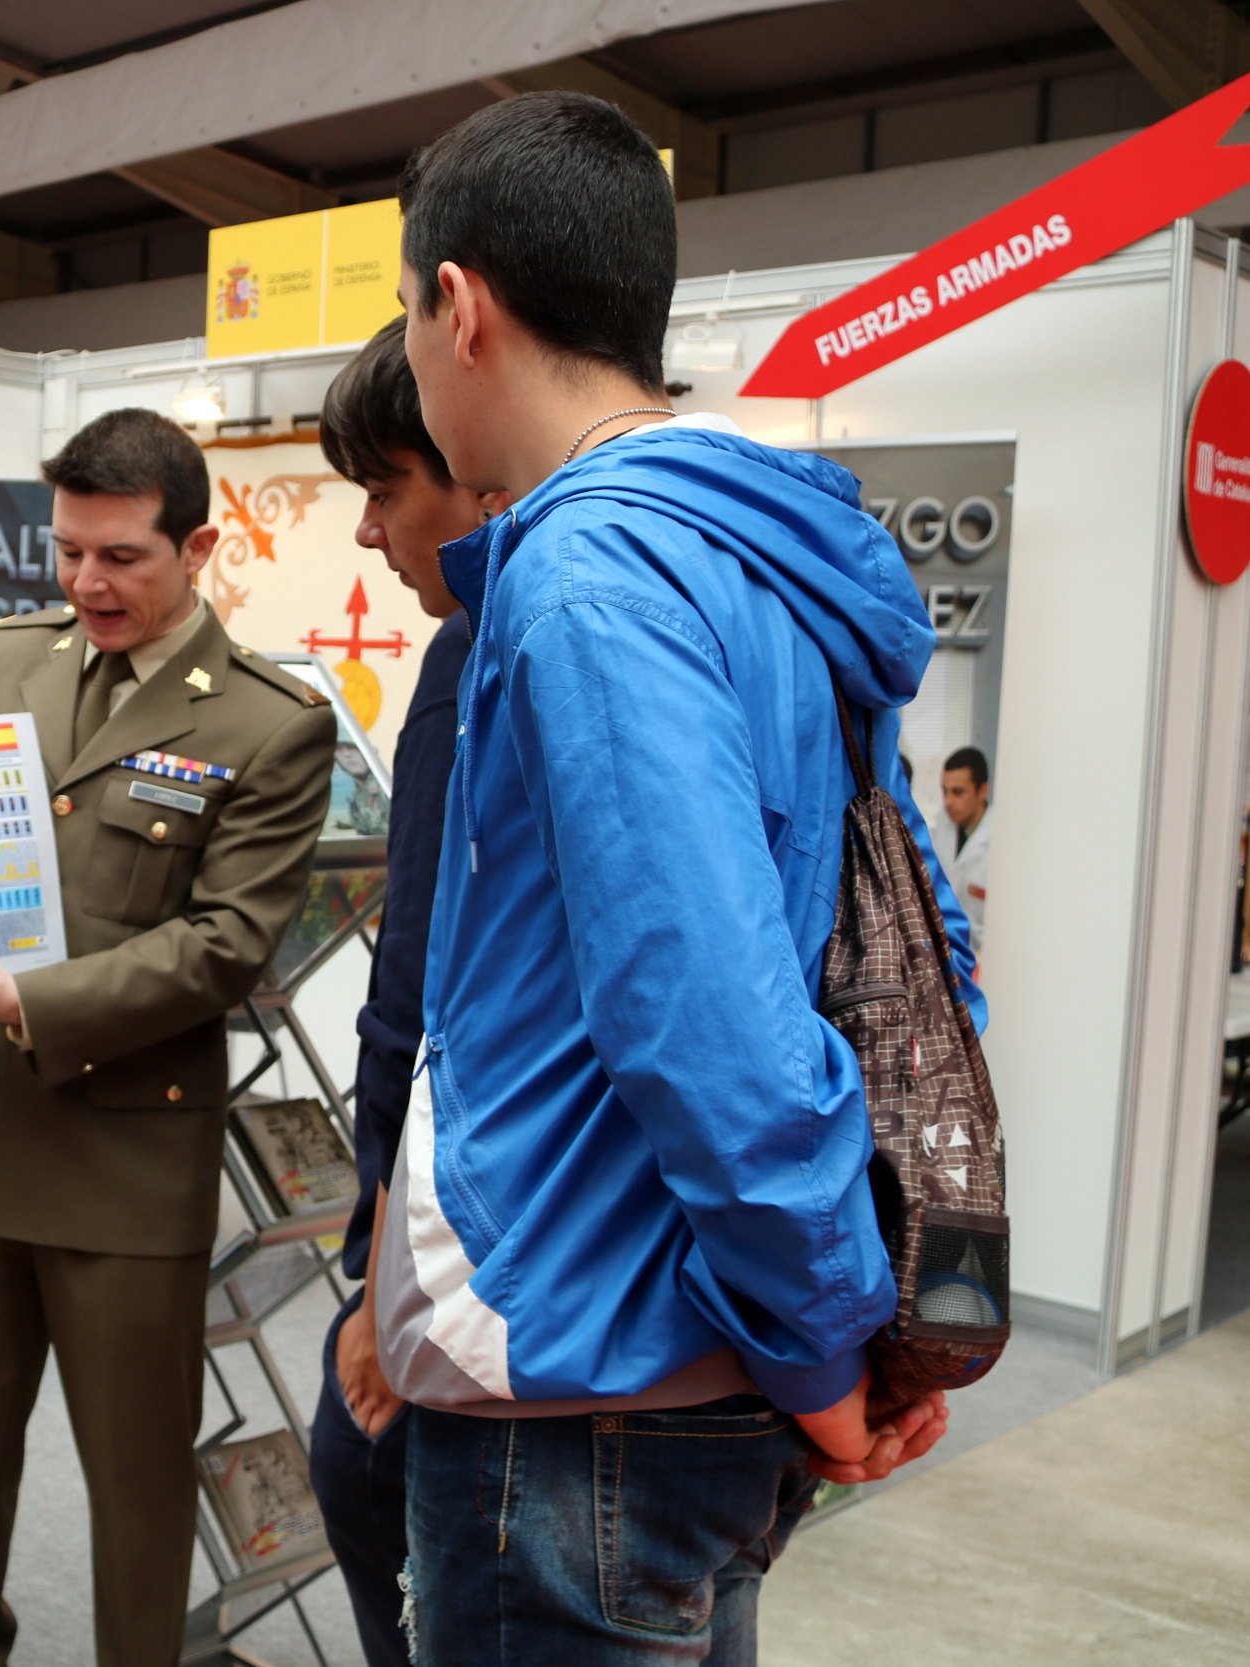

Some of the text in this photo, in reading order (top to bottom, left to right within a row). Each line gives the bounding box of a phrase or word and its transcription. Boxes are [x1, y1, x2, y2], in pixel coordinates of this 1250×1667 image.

[333, 260, 381, 274] MINISTERIO
[267, 269, 312, 284] GOBIERNO
[333, 273, 382, 287] DE DEFENSA
[266, 282, 312, 297] DE ESPAÑA
[815, 214, 1072, 366] FUERZAS ARMADAS
[867, 495, 999, 562] ZGO
[927, 584, 993, 648] EZ
